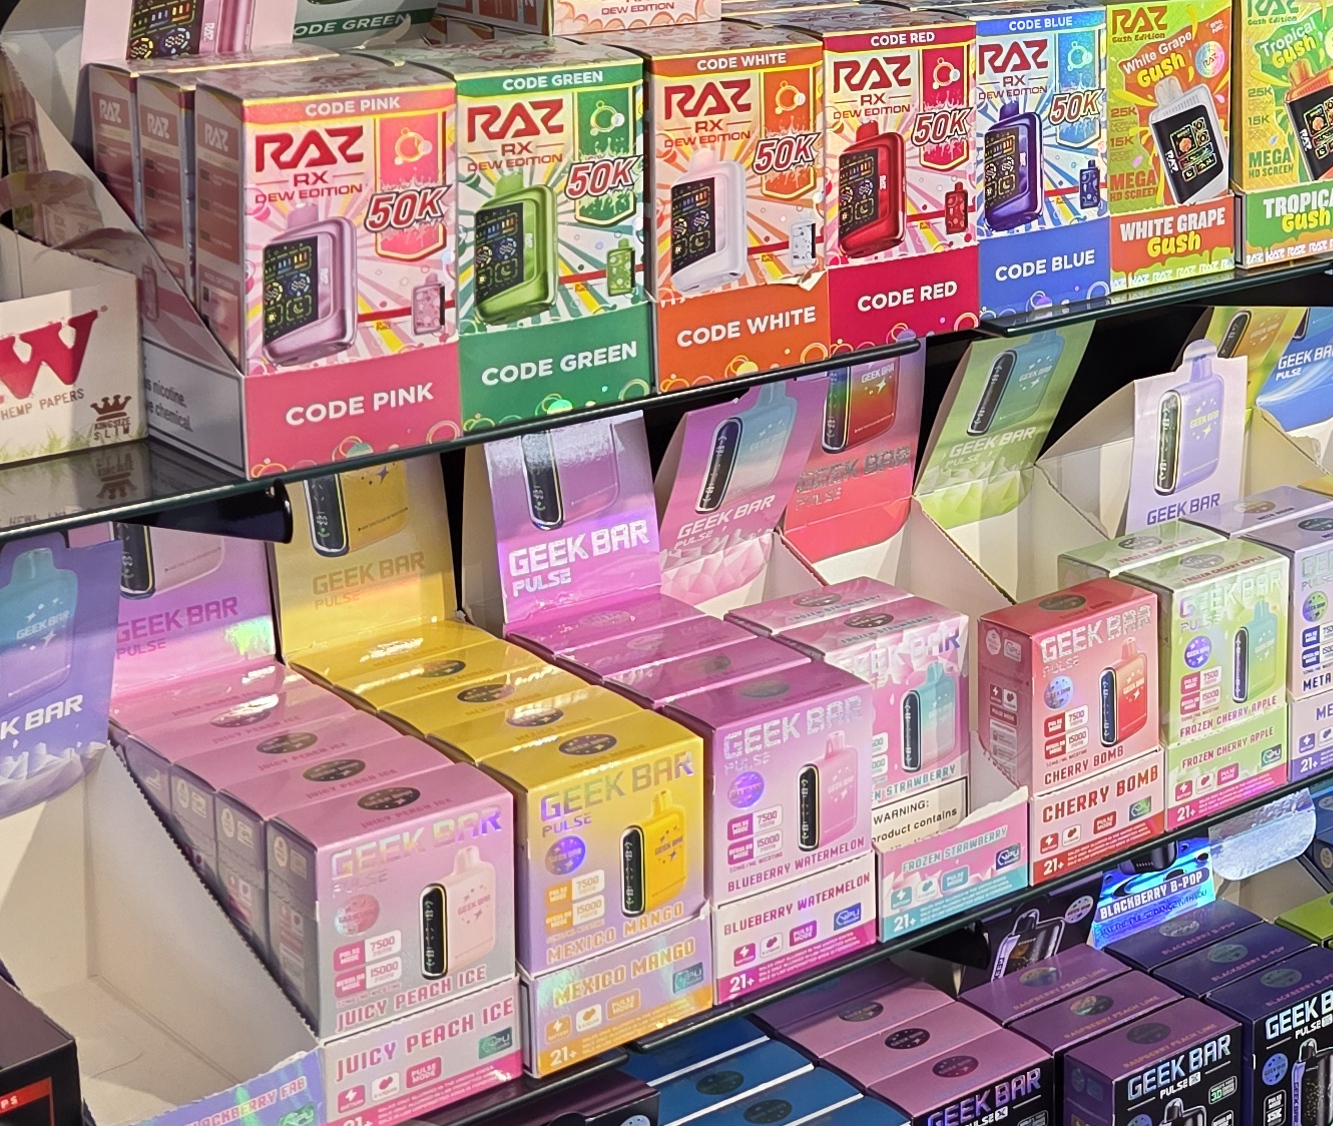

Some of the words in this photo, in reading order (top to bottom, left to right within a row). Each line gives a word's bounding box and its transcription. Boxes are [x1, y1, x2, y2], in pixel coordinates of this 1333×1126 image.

[1120, 219, 1170, 242] WHITE
[1175, 207, 1226, 232] GRAPE
[1282, 208, 1331, 231] Gush
[995, 262, 1047, 282] CODE
[1051, 249, 1096, 271] BLUE
[1147, 232, 1201, 256] Gush
[857, 292, 914, 312] CODE
[920, 281, 958, 300] RED
[676, 322, 738, 348] CODE
[741, 307, 817, 336] WHITE
[481, 362, 552, 387] CODE
[560, 341, 638, 372] GREEN
[38, 388, 85, 412] PAPERS
[286, 404, 366, 428] CODE
[373, 382, 434, 411] PINK
[507, 534, 591, 576] GEEK
[593, 518, 650, 557] BAR
[512, 568, 572, 597] PULSE
[1042, 790, 1112, 824] CHERRY
[1117, 764, 1159, 799] BOMB
[331, 828, 425, 880] GEEK
[432, 805, 503, 851] BAR
[723, 899, 793, 936] BLUEBERRY
[797, 872, 871, 912] WATERMELON
[1100, 885, 1165, 920] BLACKBERRY
[1169, 870, 1203, 899] B-POP
[336, 1042, 397, 1084] JUICY
[406, 1014, 477, 1061] PEACH
[481, 998, 513, 1034] ICE
